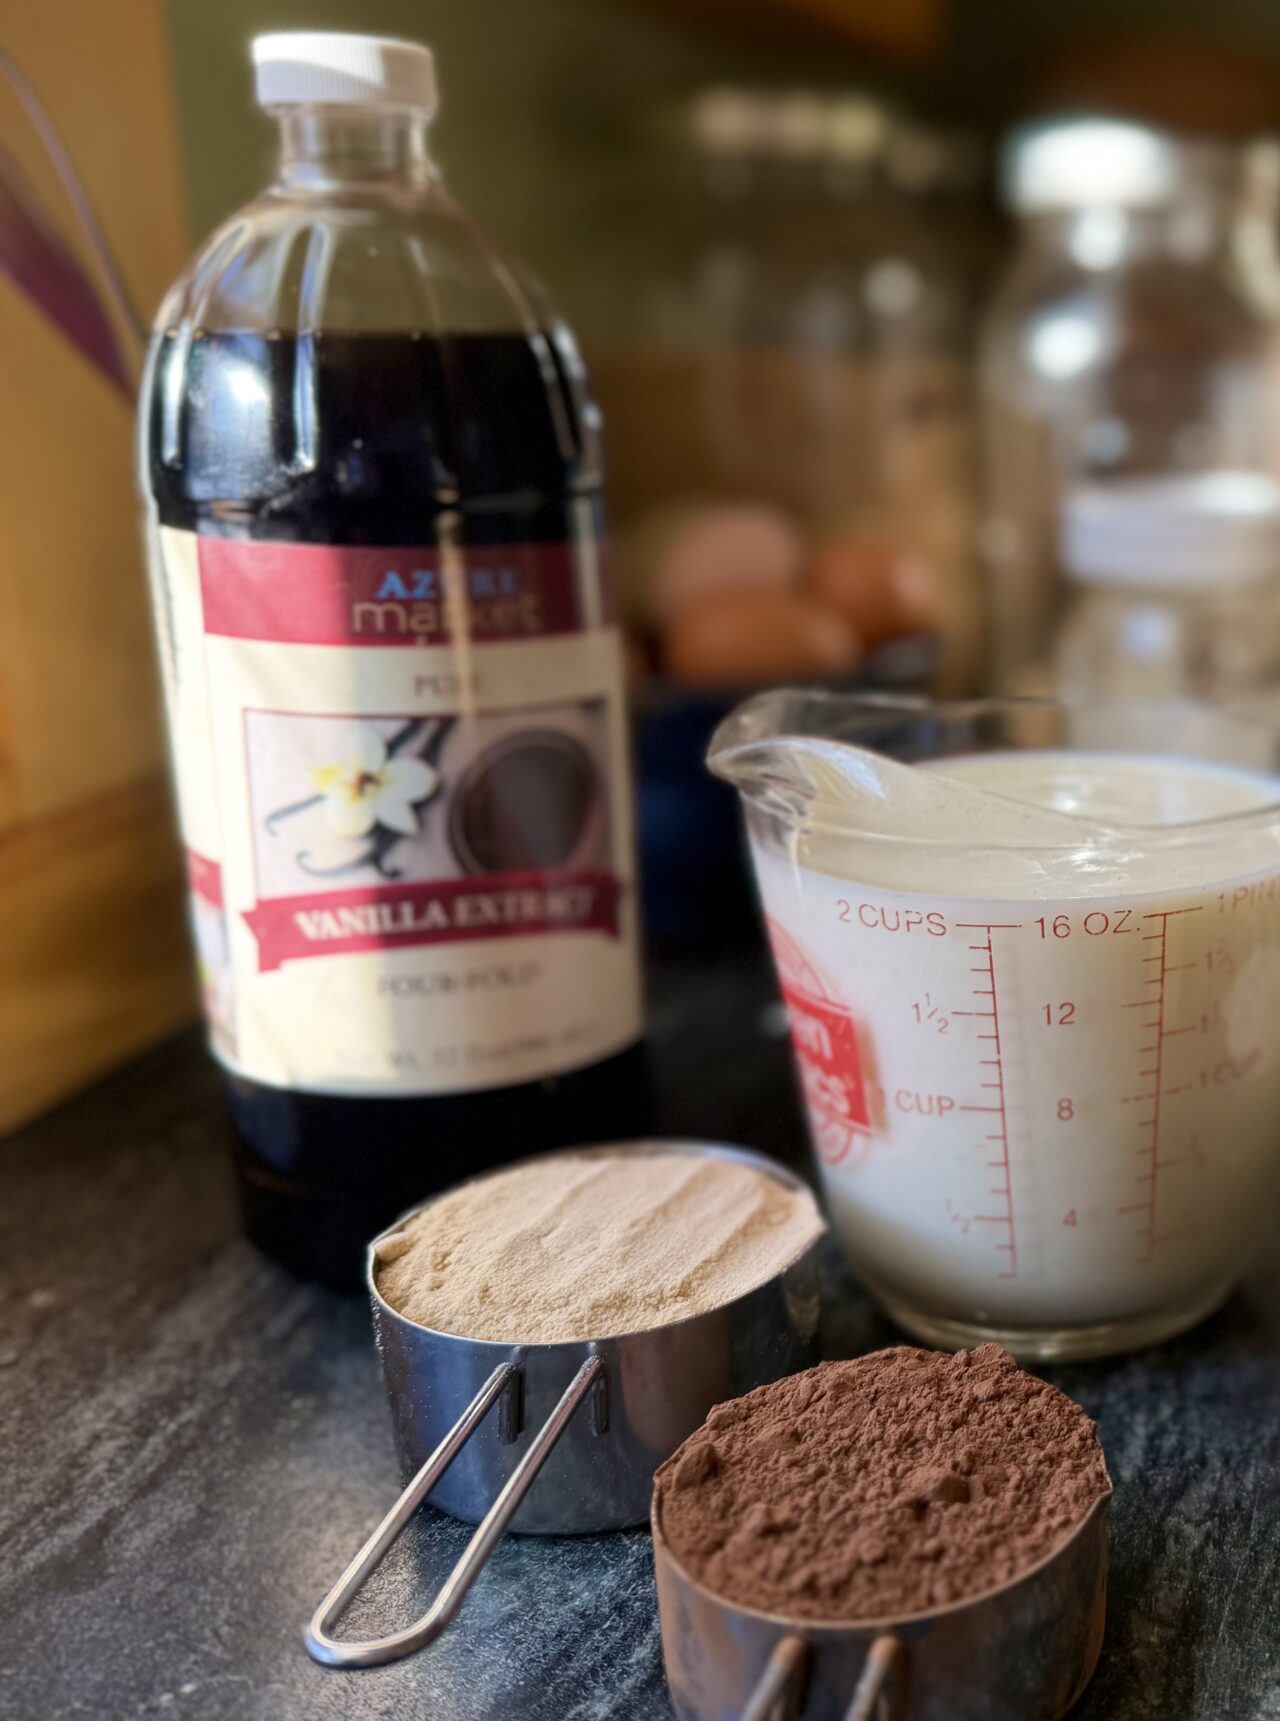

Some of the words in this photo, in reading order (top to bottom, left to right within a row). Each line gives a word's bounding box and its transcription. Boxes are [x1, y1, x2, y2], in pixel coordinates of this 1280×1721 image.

[376, 569, 517, 600] AZRE
[352, 593, 542, 635] maket
[292, 898, 450, 942] VANILLA
[837, 898, 851, 923] 2
[858, 903, 947, 937] CUPS
[1034, 914, 1072, 939] 16
[1083, 909, 1141, 936] OZ.
[1043, 1002, 1076, 1026] 12
[894, 1088, 956, 1118] CUP
[1056, 1097, 1075, 1121] 8
[1062, 1208, 1078, 1228] 4
